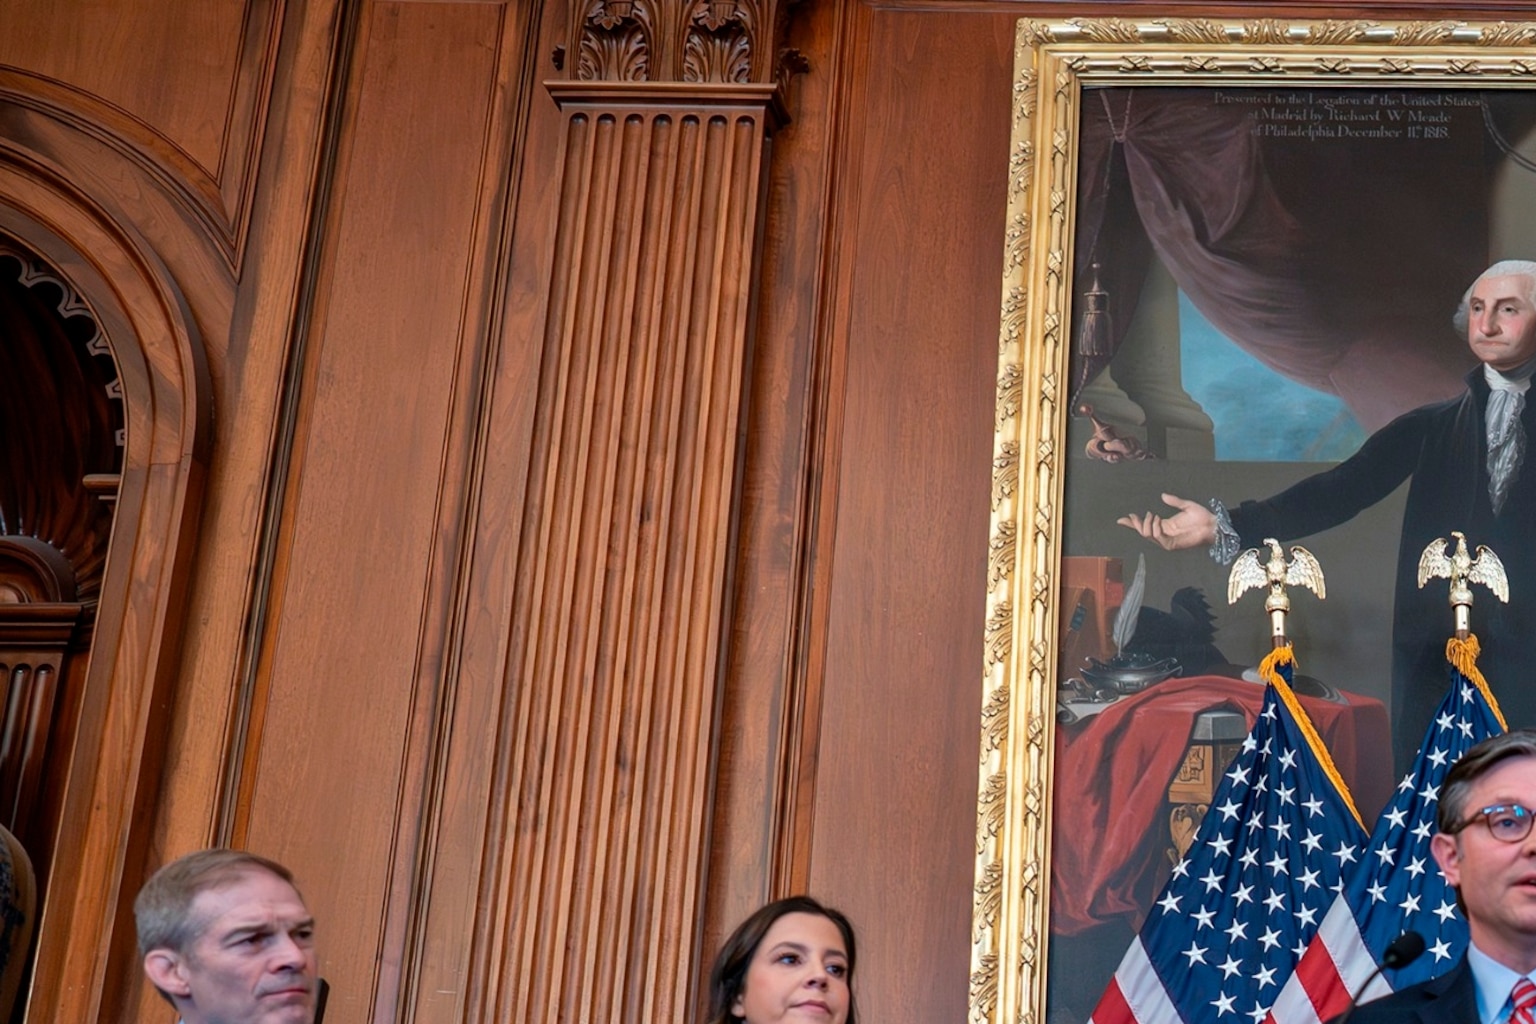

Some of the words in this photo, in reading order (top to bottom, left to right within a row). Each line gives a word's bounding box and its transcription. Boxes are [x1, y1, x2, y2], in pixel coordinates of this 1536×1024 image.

[1214, 91, 1271, 105] Presented
[1275, 95, 1287, 104] to
[1289, 93, 1306, 104] the
[1364, 94, 1377, 105] of
[1379, 94, 1400, 106] the
[1402, 94, 1442, 106] United
[1443, 94, 1482, 107] States
[1262, 107, 1308, 121] Madrid
[1310, 109, 1324, 126] by
[1328, 109, 1380, 121] Richard
[1407, 110, 1451, 122] Meade
[1265, 124, 1335, 141] Philadelphia
[1337, 124, 1402, 138] December
